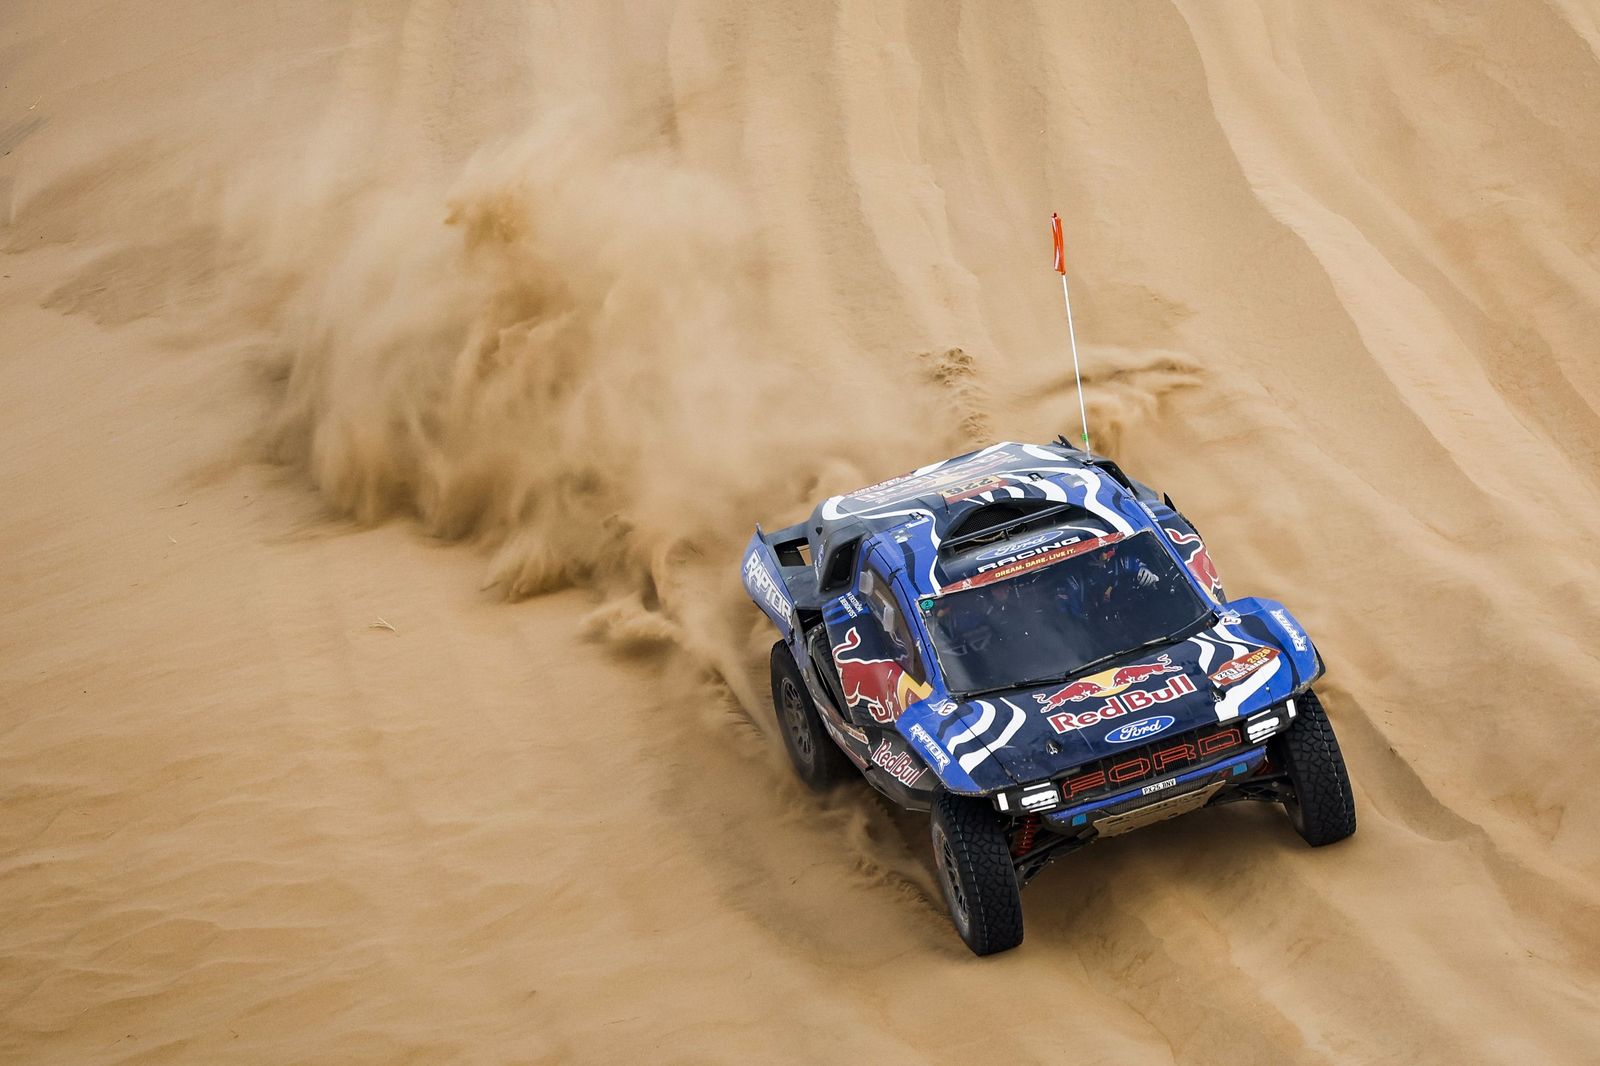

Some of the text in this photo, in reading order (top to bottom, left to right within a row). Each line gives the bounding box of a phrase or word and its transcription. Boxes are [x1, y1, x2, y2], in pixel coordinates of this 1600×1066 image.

[977, 535, 1082, 573] RACING
[994, 533, 1052, 557] Ford
[995, 547, 1077, 578] DREAM. DARE. LIVE IT.
[743, 549, 794, 625] RAPTOR
[1047, 673, 1197, 734] Red Bull
[908, 723, 951, 775] RAPTOR
[1119, 719, 1162, 740] Ford
[1062, 728, 1242, 799] FORD
